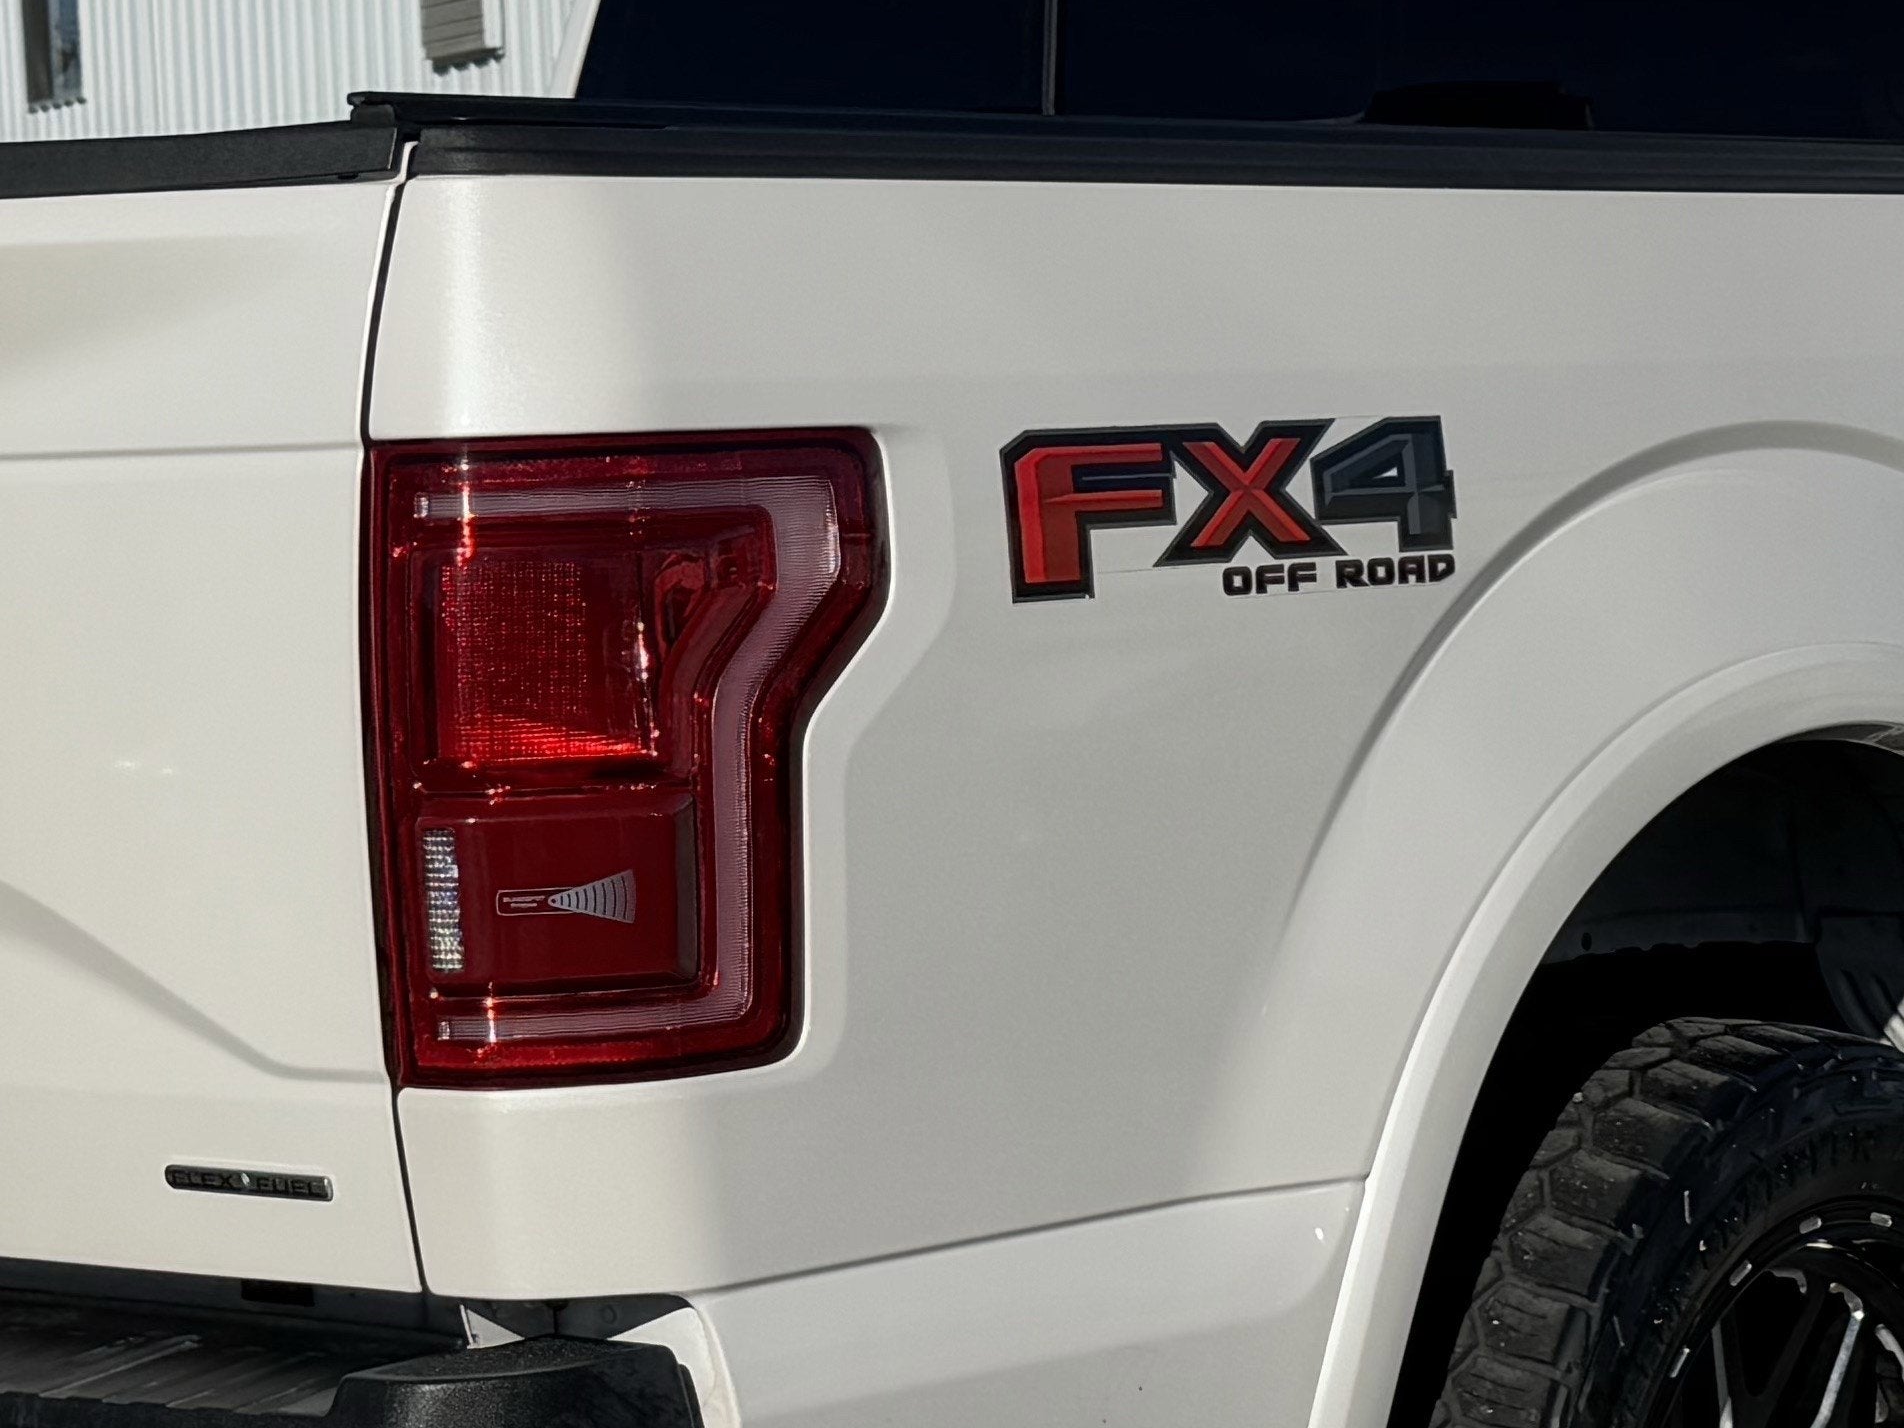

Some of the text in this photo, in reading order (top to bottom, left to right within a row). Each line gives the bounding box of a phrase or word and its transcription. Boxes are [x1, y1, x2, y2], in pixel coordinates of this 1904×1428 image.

[999, 415, 1457, 604] FX4
[1222, 553, 1456, 597] OFF ROAD
